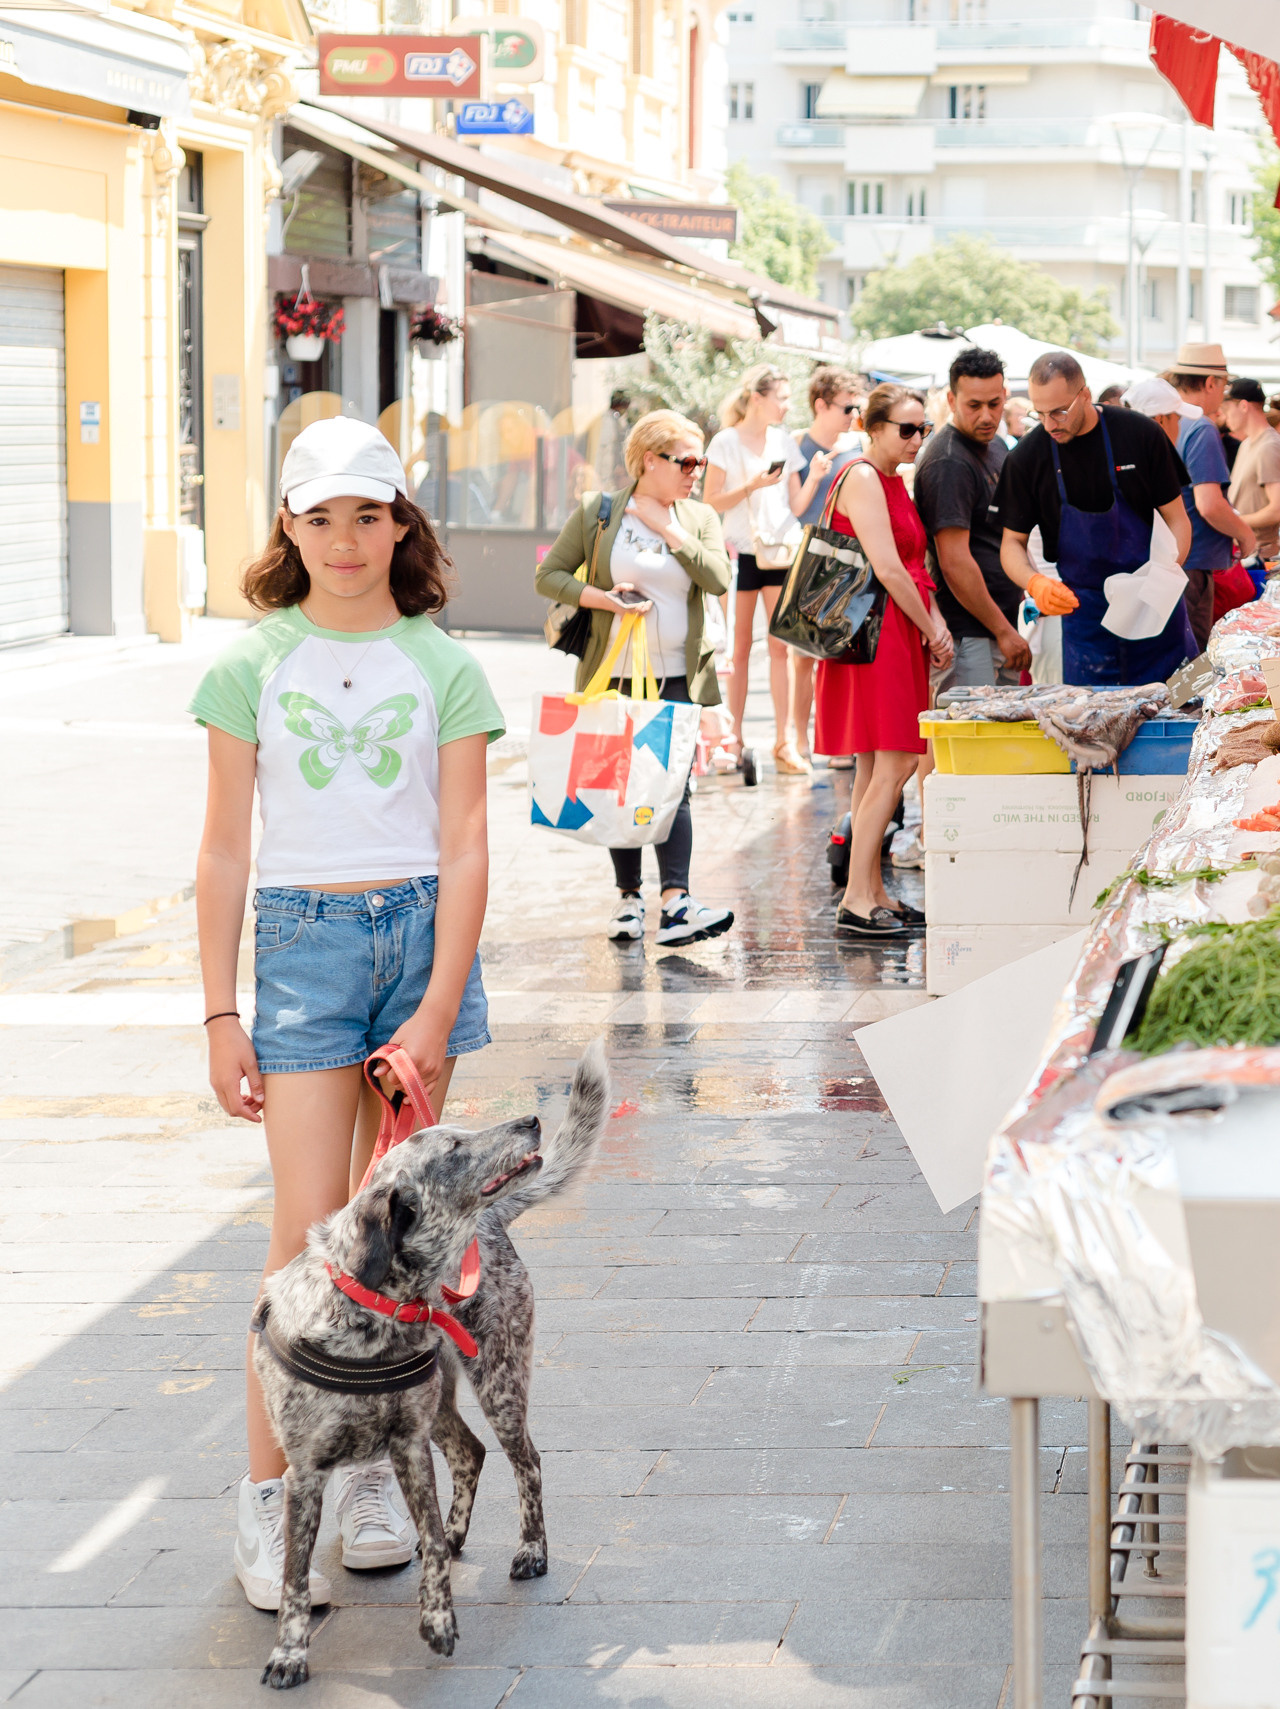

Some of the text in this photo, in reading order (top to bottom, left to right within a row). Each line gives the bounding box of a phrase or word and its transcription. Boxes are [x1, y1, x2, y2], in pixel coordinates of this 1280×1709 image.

[332, 58, 367, 74] PMU
[408, 57, 443, 74] FDJ
[464, 105, 498, 121] FDJ
[993, 813, 1100, 823] RASED IN THE WILD
